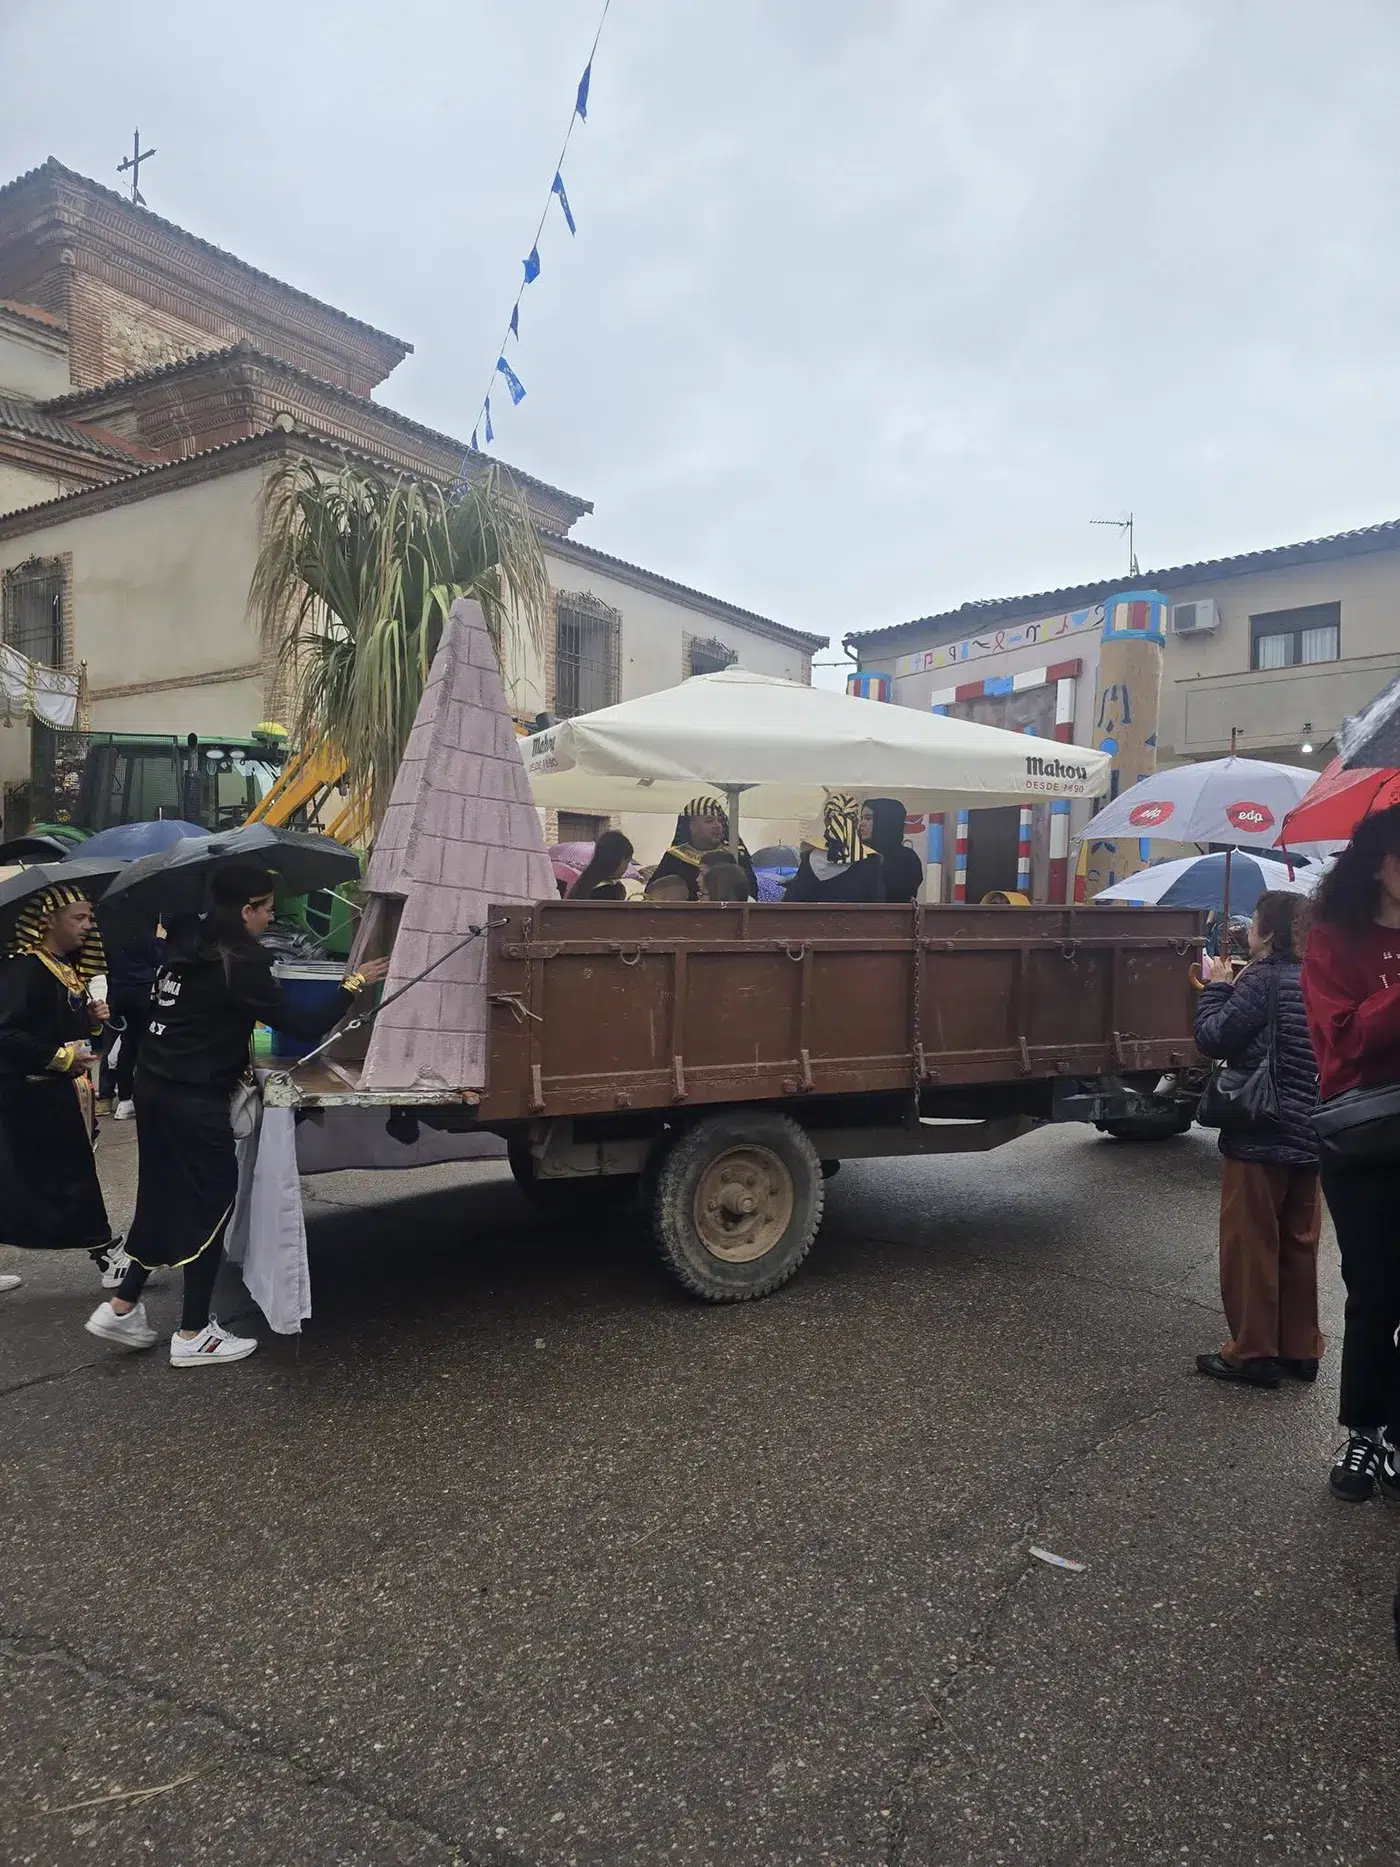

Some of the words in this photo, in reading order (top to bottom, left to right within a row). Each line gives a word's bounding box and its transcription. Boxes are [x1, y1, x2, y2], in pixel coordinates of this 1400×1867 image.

[1025, 756, 1087, 780] Mahou
[1025, 780, 1059, 792] DESDE
[1063, 784, 1084, 793] 1890
[1238, 809, 1264, 823] edp
